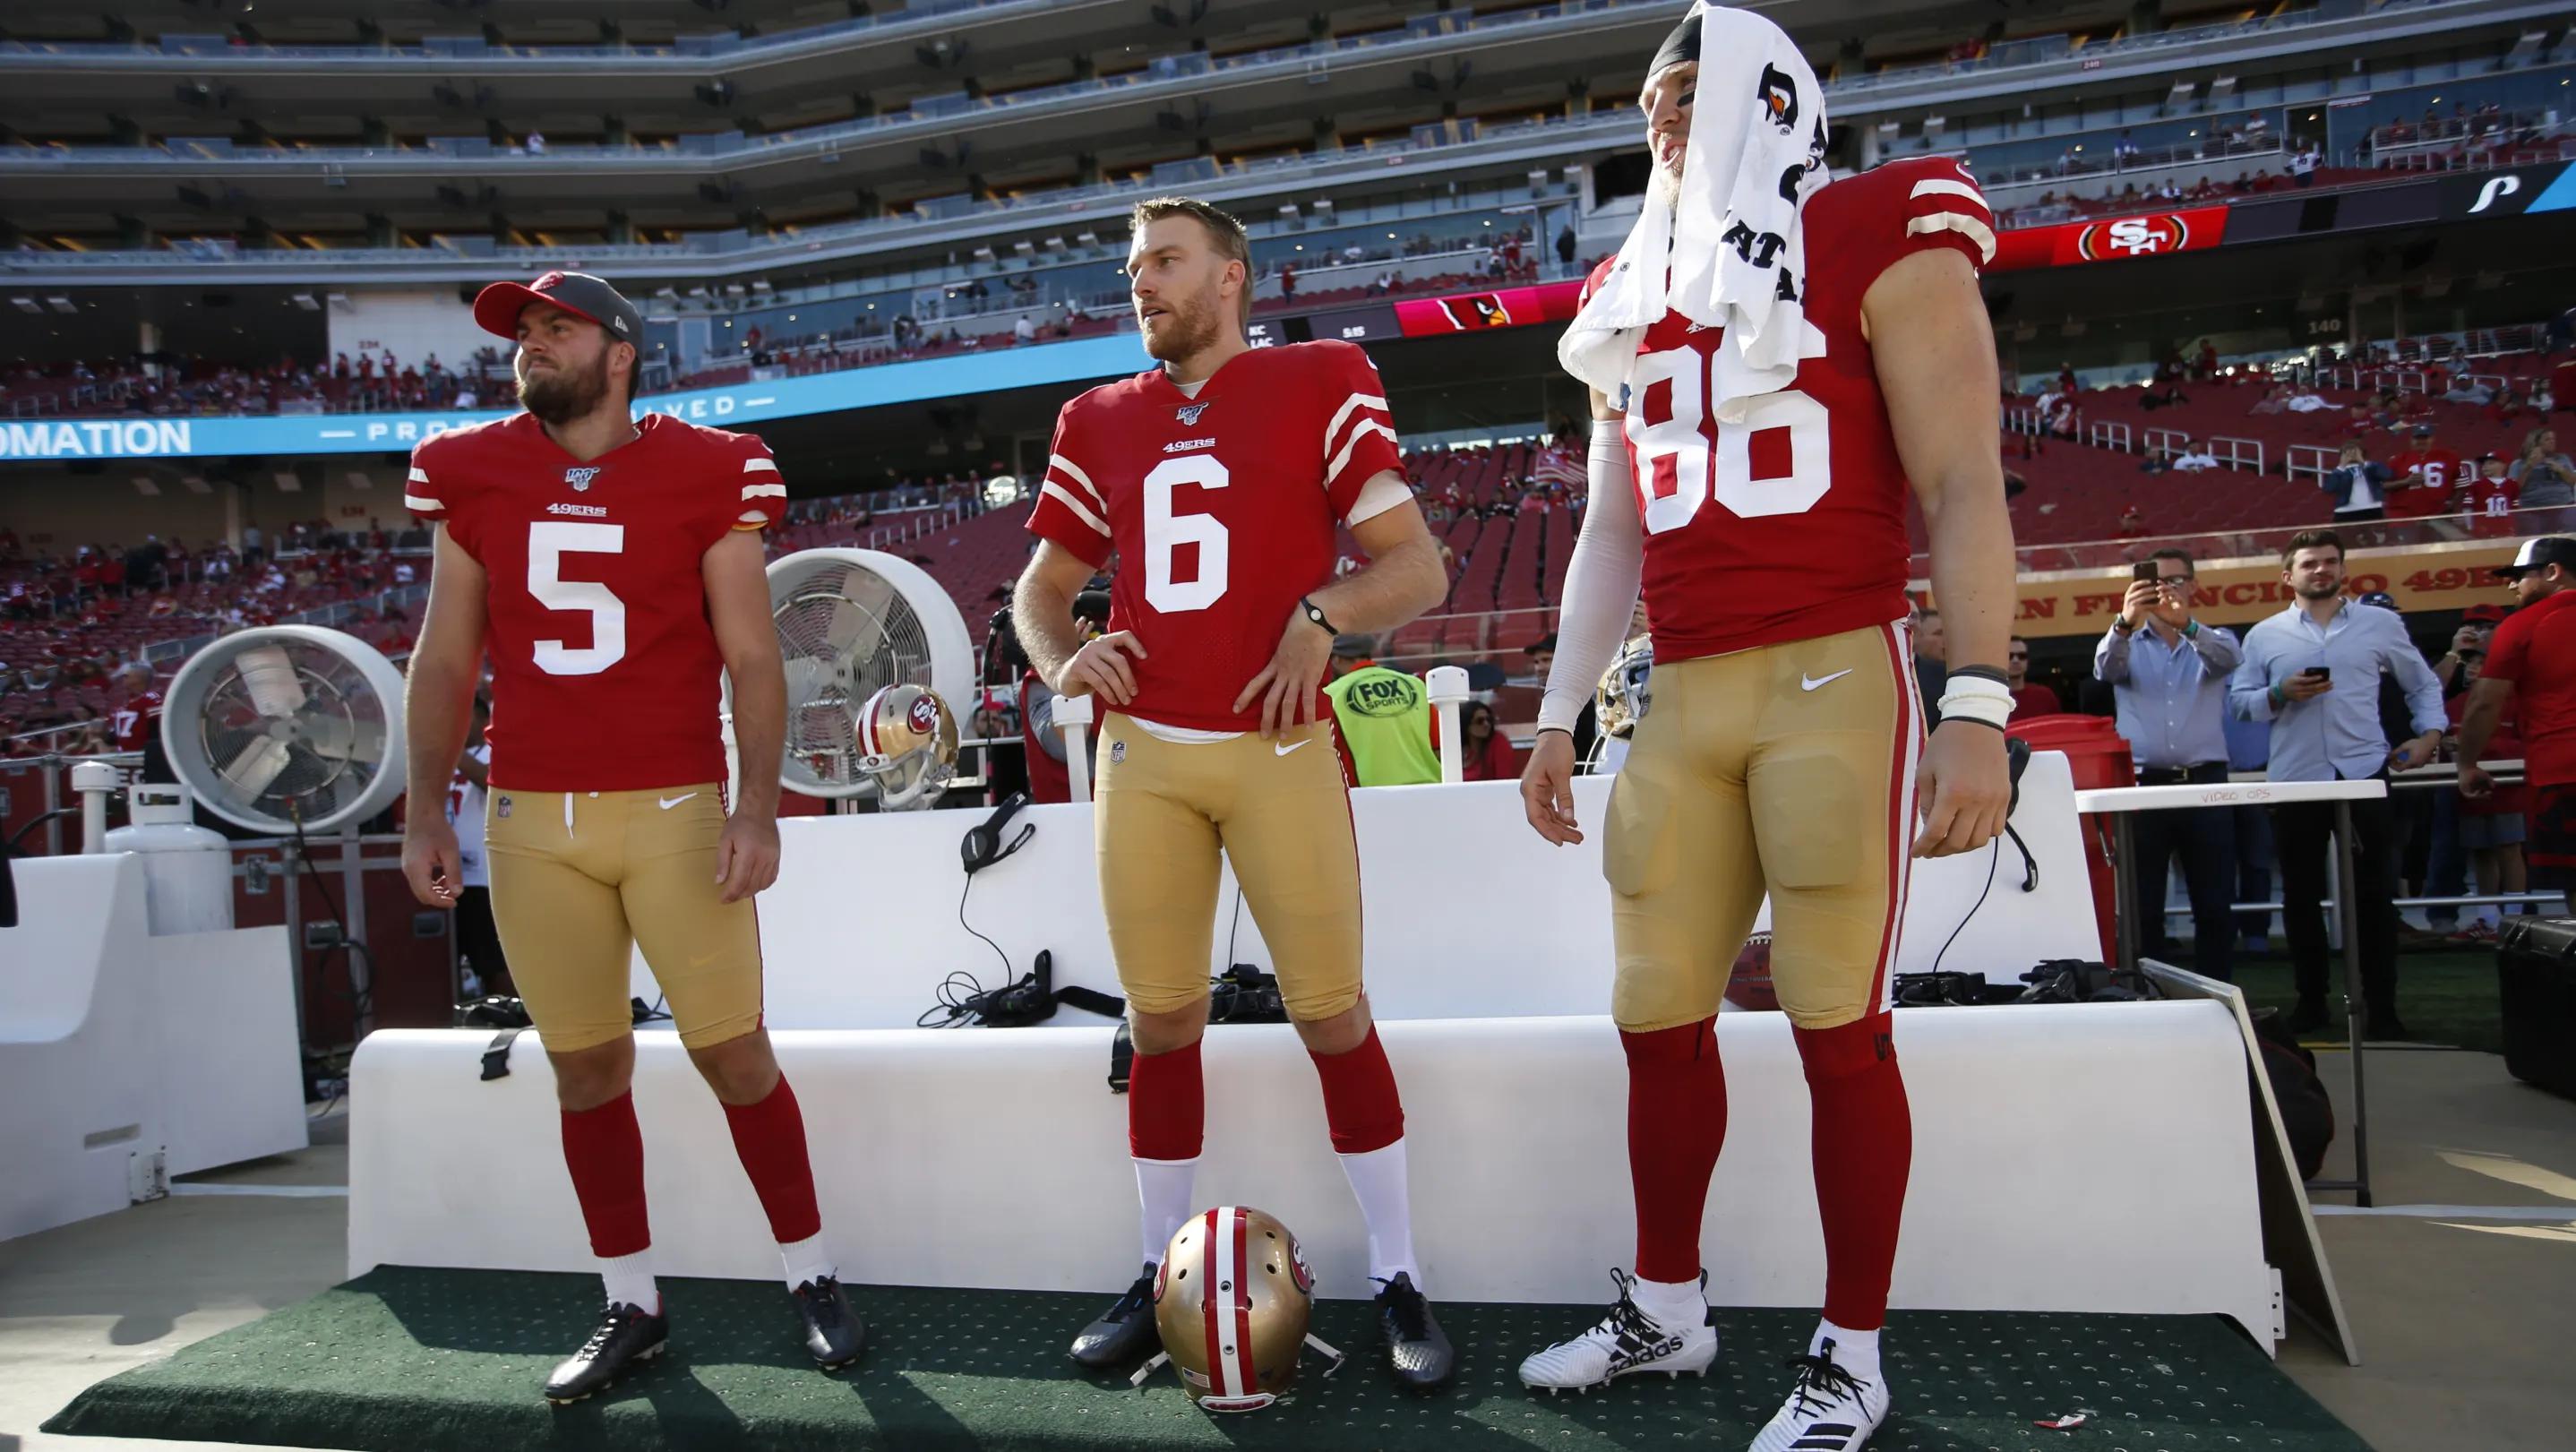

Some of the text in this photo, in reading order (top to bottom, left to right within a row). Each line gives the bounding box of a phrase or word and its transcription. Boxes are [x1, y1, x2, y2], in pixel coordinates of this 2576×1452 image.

[2308, 319, 2342, 335] 140
[0, 421, 192, 457] MATION
[1626, 320, 1832, 536] 86
[1163, 437, 1215, 453] 49ERS
[545, 503, 608, 518] 49ERS
[1144, 453, 1230, 614] 6
[2400, 564, 2511, 593] 49E
[528, 520, 626, 675] 5
[1358, 679, 1405, 703] FOX
[1366, 695, 1410, 710] SPORTS
[2201, 788, 2271, 803] VIDEO OPS
[1605, 1335, 1684, 1378] adidas
